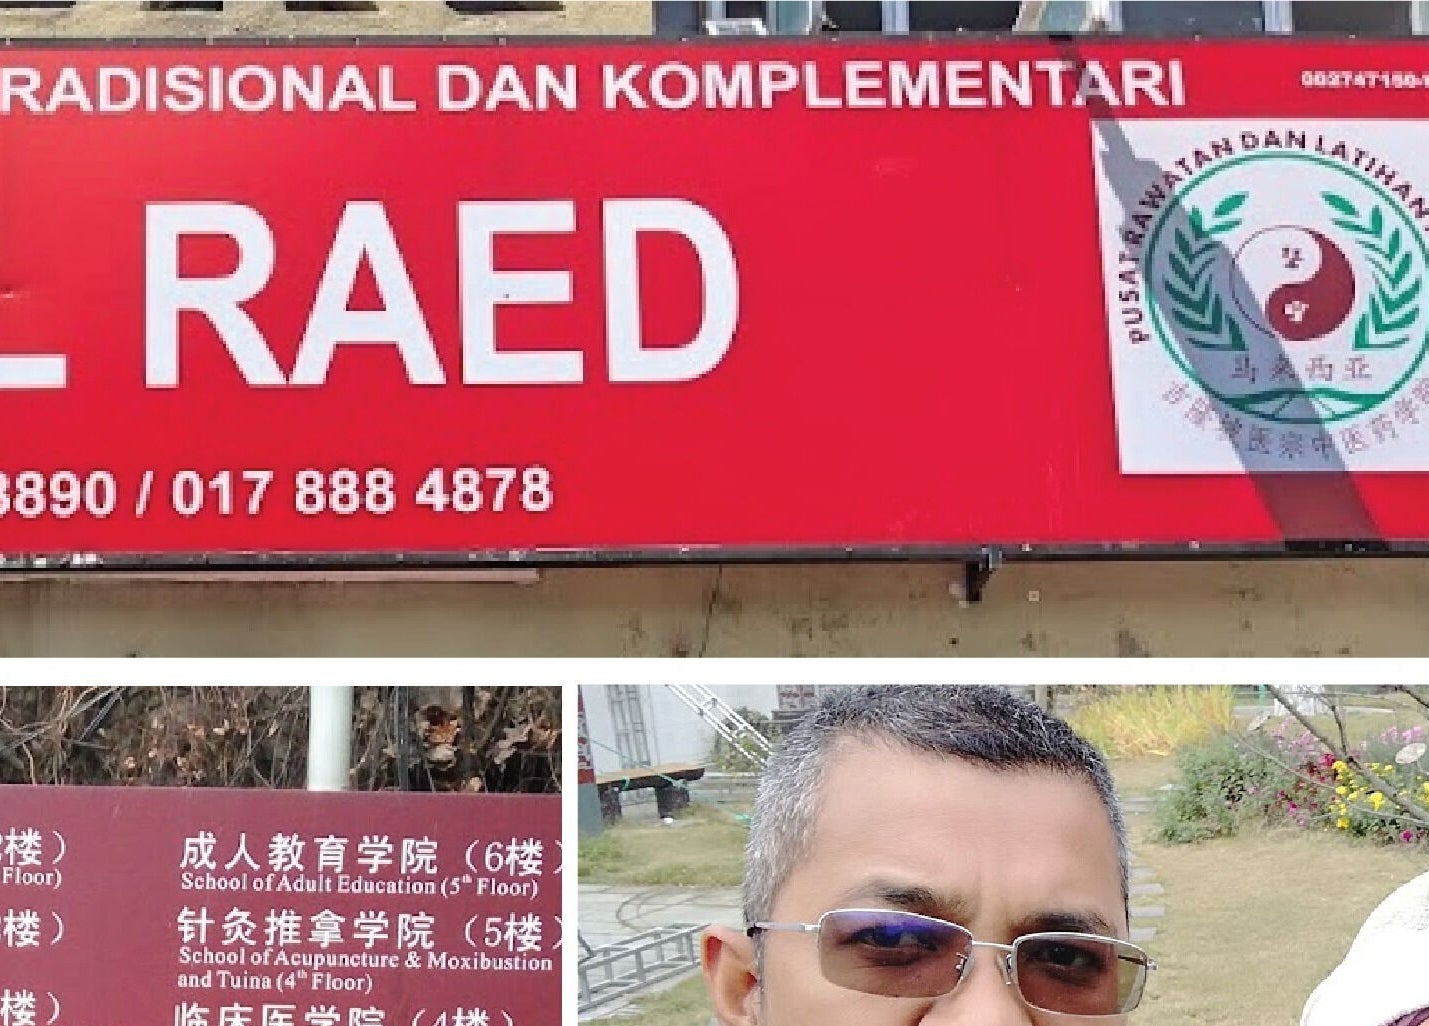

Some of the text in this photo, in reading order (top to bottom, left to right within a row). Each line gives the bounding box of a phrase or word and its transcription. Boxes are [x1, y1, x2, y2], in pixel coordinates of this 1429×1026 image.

[439, 63, 578, 113] DAN
[604, 59, 1187, 112] KOMPLEMENTARI
[1240, 130, 1307, 151] DAN
[1127, 137, 1235, 247] RAWATAN
[144, 198, 741, 389] RAED
[1118, 251, 1150, 345] PUSAT
[172, 470, 275, 517] 017
[295, 468, 397, 515] 888
[415, 466, 555, 514] 4878
[2, 866, 62, 889] Floor)
[181, 872, 247, 890] School
[252, 872, 274, 891] of
[275, 873, 332, 893] Adult
[337, 875, 436, 895] Education
[476, 877, 539, 899] Floor)
[179, 948, 553, 972] School of Acupuncture & Moxibustion
[177, 971, 211, 988] and
[215, 971, 272, 990] Tuina
[311, 973, 373, 993] Floor)
